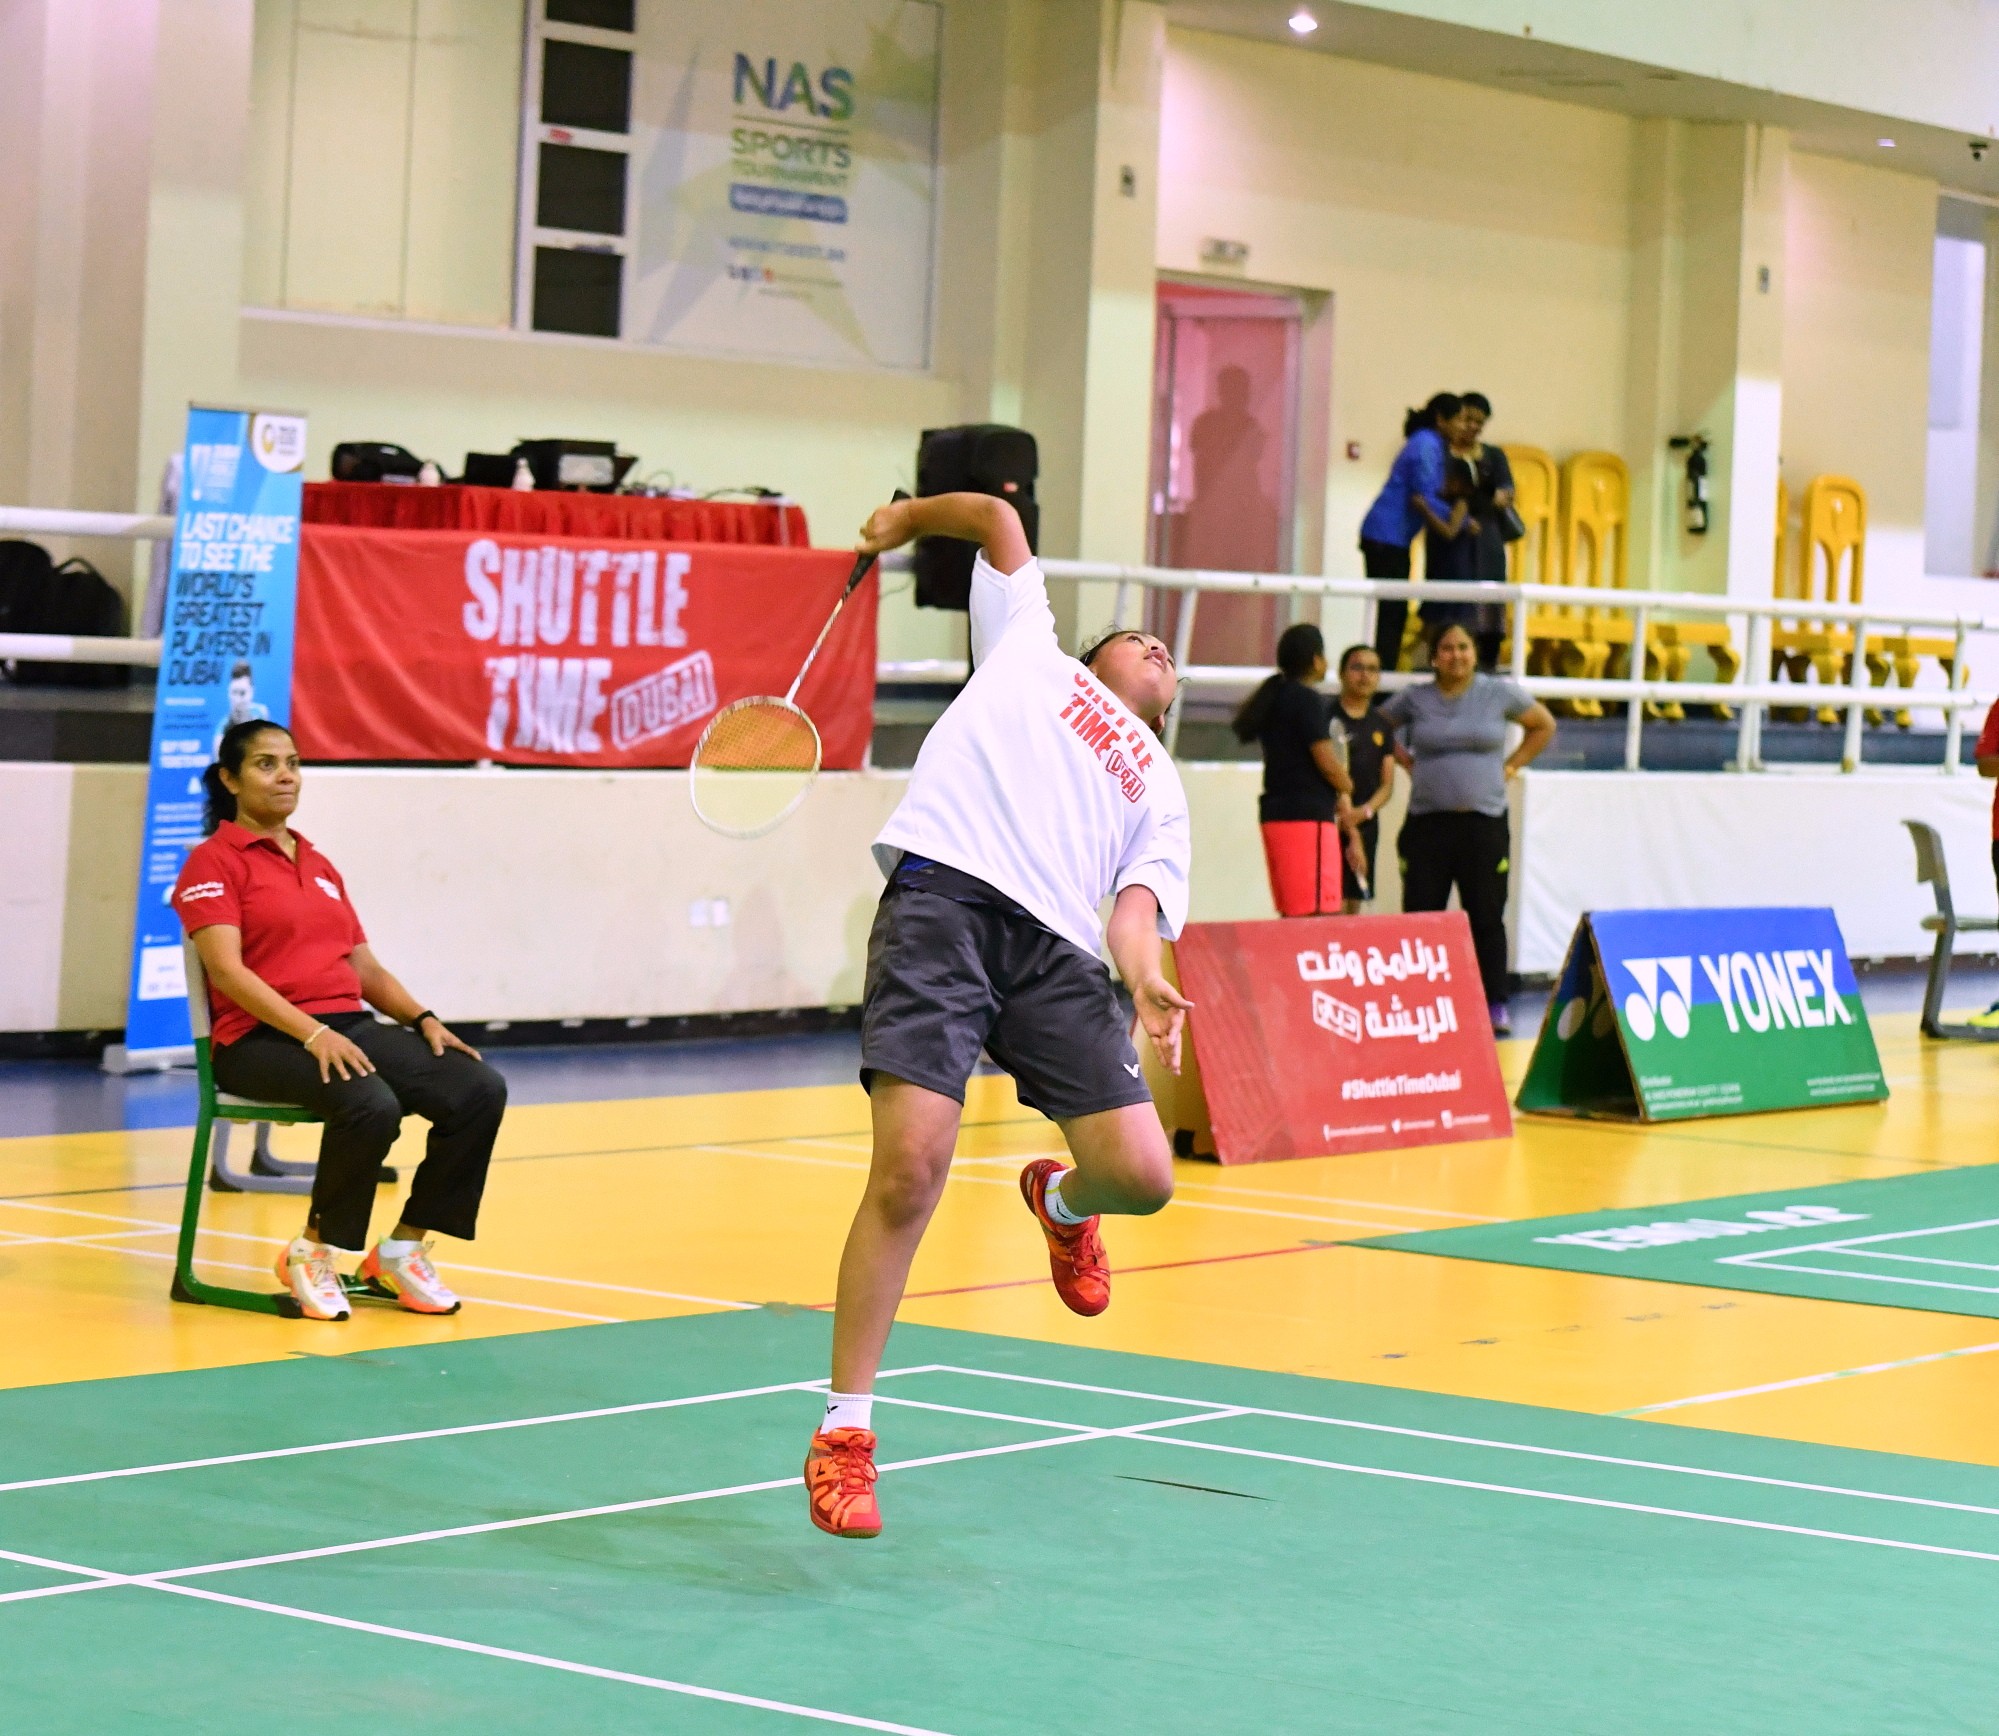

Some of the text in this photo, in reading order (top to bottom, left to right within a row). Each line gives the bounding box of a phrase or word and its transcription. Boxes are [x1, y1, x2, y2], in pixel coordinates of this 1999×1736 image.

[734, 52, 854, 121] NAS
[731, 127, 851, 169] SPORTS
[181, 511, 296, 545] LAST CHANCE
[178, 541, 277, 573] TO SEE THE
[176, 572, 255, 599] WORLD'S
[462, 537, 692, 648] SHUTTLE
[173, 601, 265, 628] GREATEST
[171, 629, 272, 656] PLAYERS IN
[168, 659, 222, 687] DUBAI
[484, 652, 709, 754] TIME DUBAI
[1059, 692, 1122, 762] TIME
[1111, 753, 1143, 799] DBAI
[1297, 937, 1452, 987] برنامج وقت
[1699, 948, 1853, 1034] YONEX
[1364, 993, 1459, 1044] الريشة
[1341, 1068, 1463, 1101] #ShuttleTimeDubai
